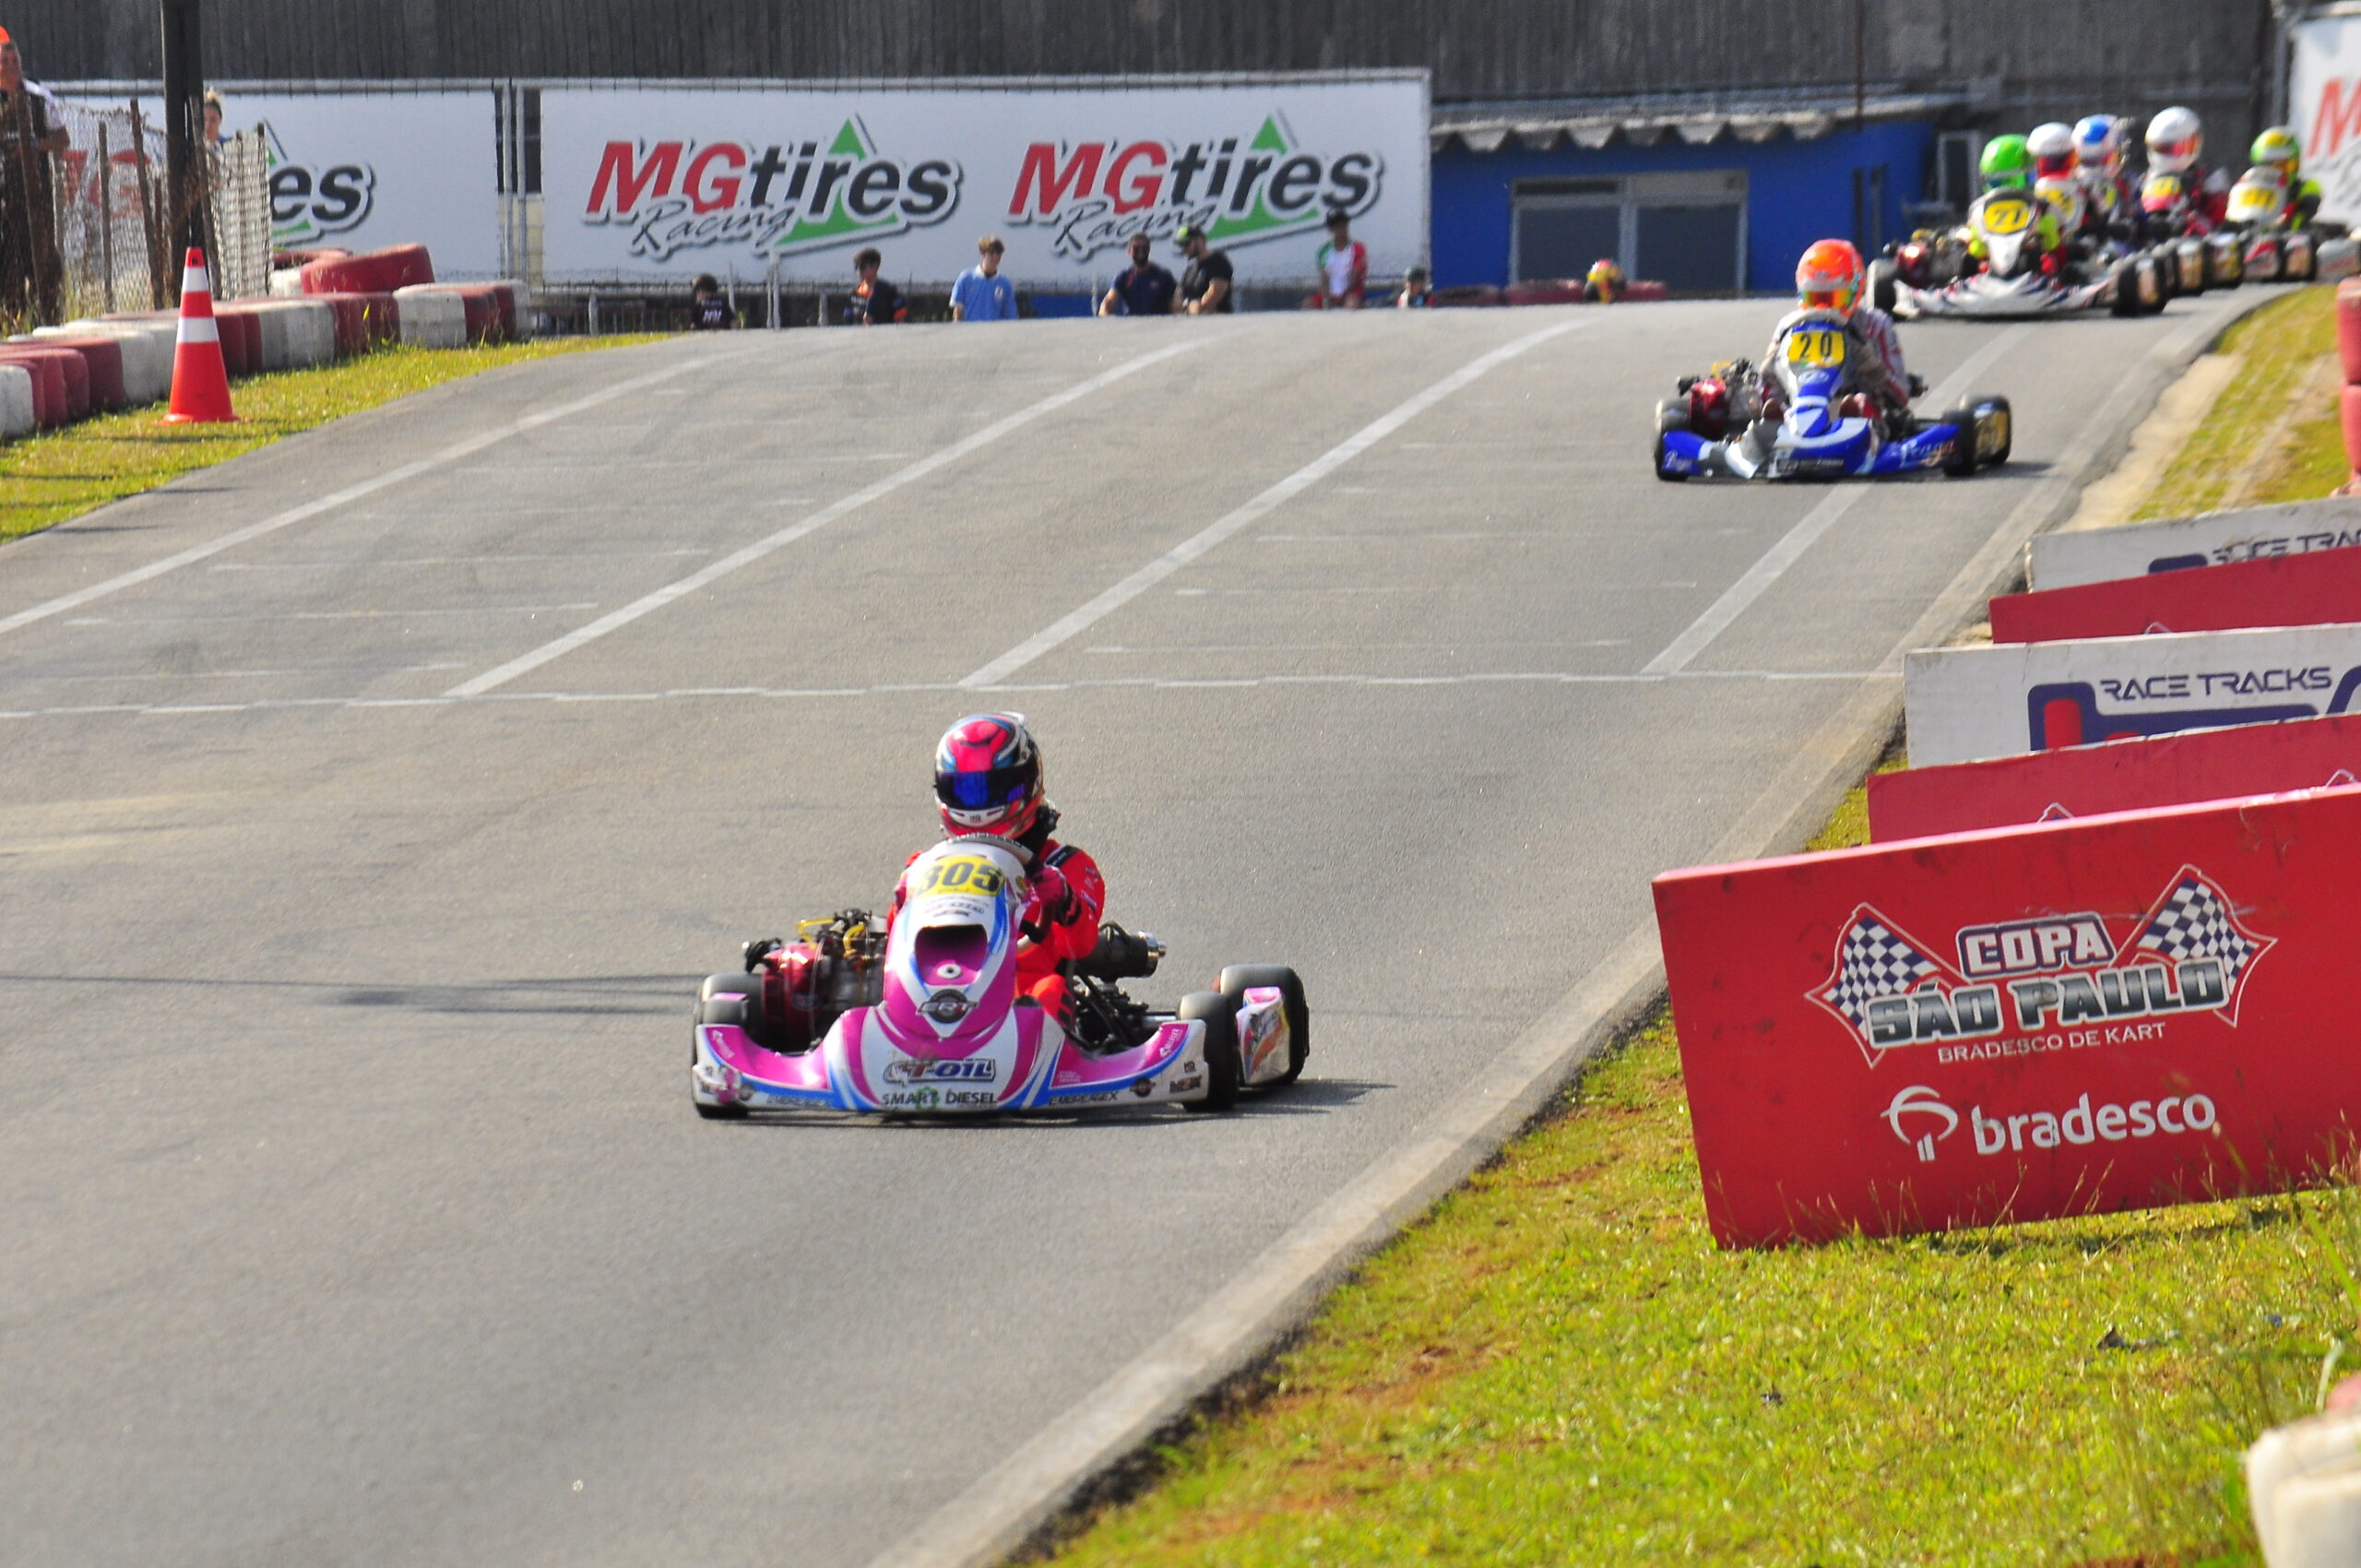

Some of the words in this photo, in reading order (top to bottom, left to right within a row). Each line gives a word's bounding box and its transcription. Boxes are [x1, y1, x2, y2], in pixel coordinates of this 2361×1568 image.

[585, 140, 953, 217] MGtires
[1007, 138, 1372, 216] MGtires
[632, 199, 795, 249] Racing
[1053, 200, 1216, 251] Racing
[1799, 331, 1833, 360] 20
[2100, 674, 2191, 701] RACE
[2197, 667, 2332, 696] TRACKS
[918, 861, 1001, 894] 305
[1964, 921, 2109, 974] COPA
[2009, 960, 2225, 1027] PAULO
[1937, 1033, 2063, 1063] BRADESCO
[2069, 1028, 2101, 1049] DE
[2105, 1022, 2165, 1045] KART
[882, 1090, 939, 1106] SMART
[944, 1089, 999, 1105] DIESEL
[1970, 1091, 2215, 1156] bradesco
